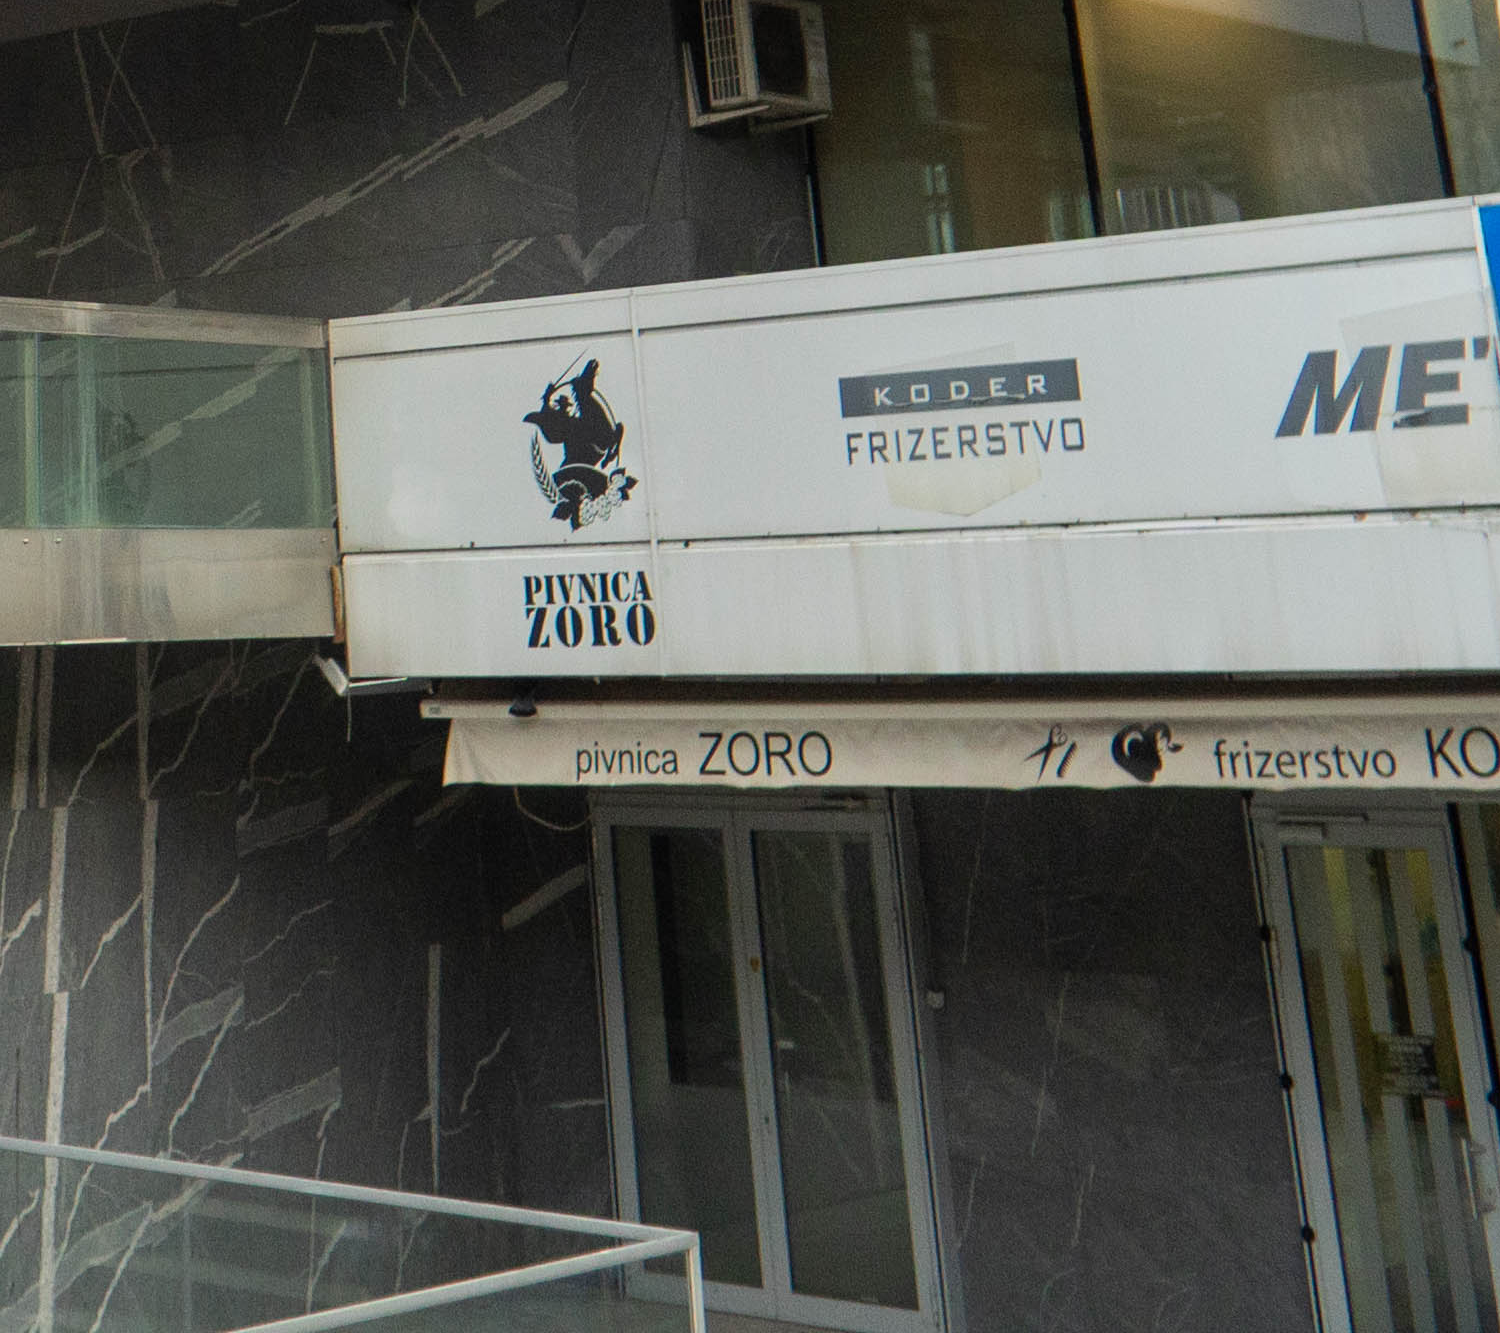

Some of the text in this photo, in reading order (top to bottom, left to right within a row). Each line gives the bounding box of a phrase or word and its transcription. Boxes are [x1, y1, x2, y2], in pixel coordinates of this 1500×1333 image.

[873, 374, 1048, 407] KODER
[846, 418, 1085, 465] FRIZERSTVO
[523, 570, 653, 605] PIVNICA
[525, 603, 656, 648] ZORO
[576, 731, 832, 782] pivnica ZORO
[1213, 740, 1397, 778] frizerstvo
